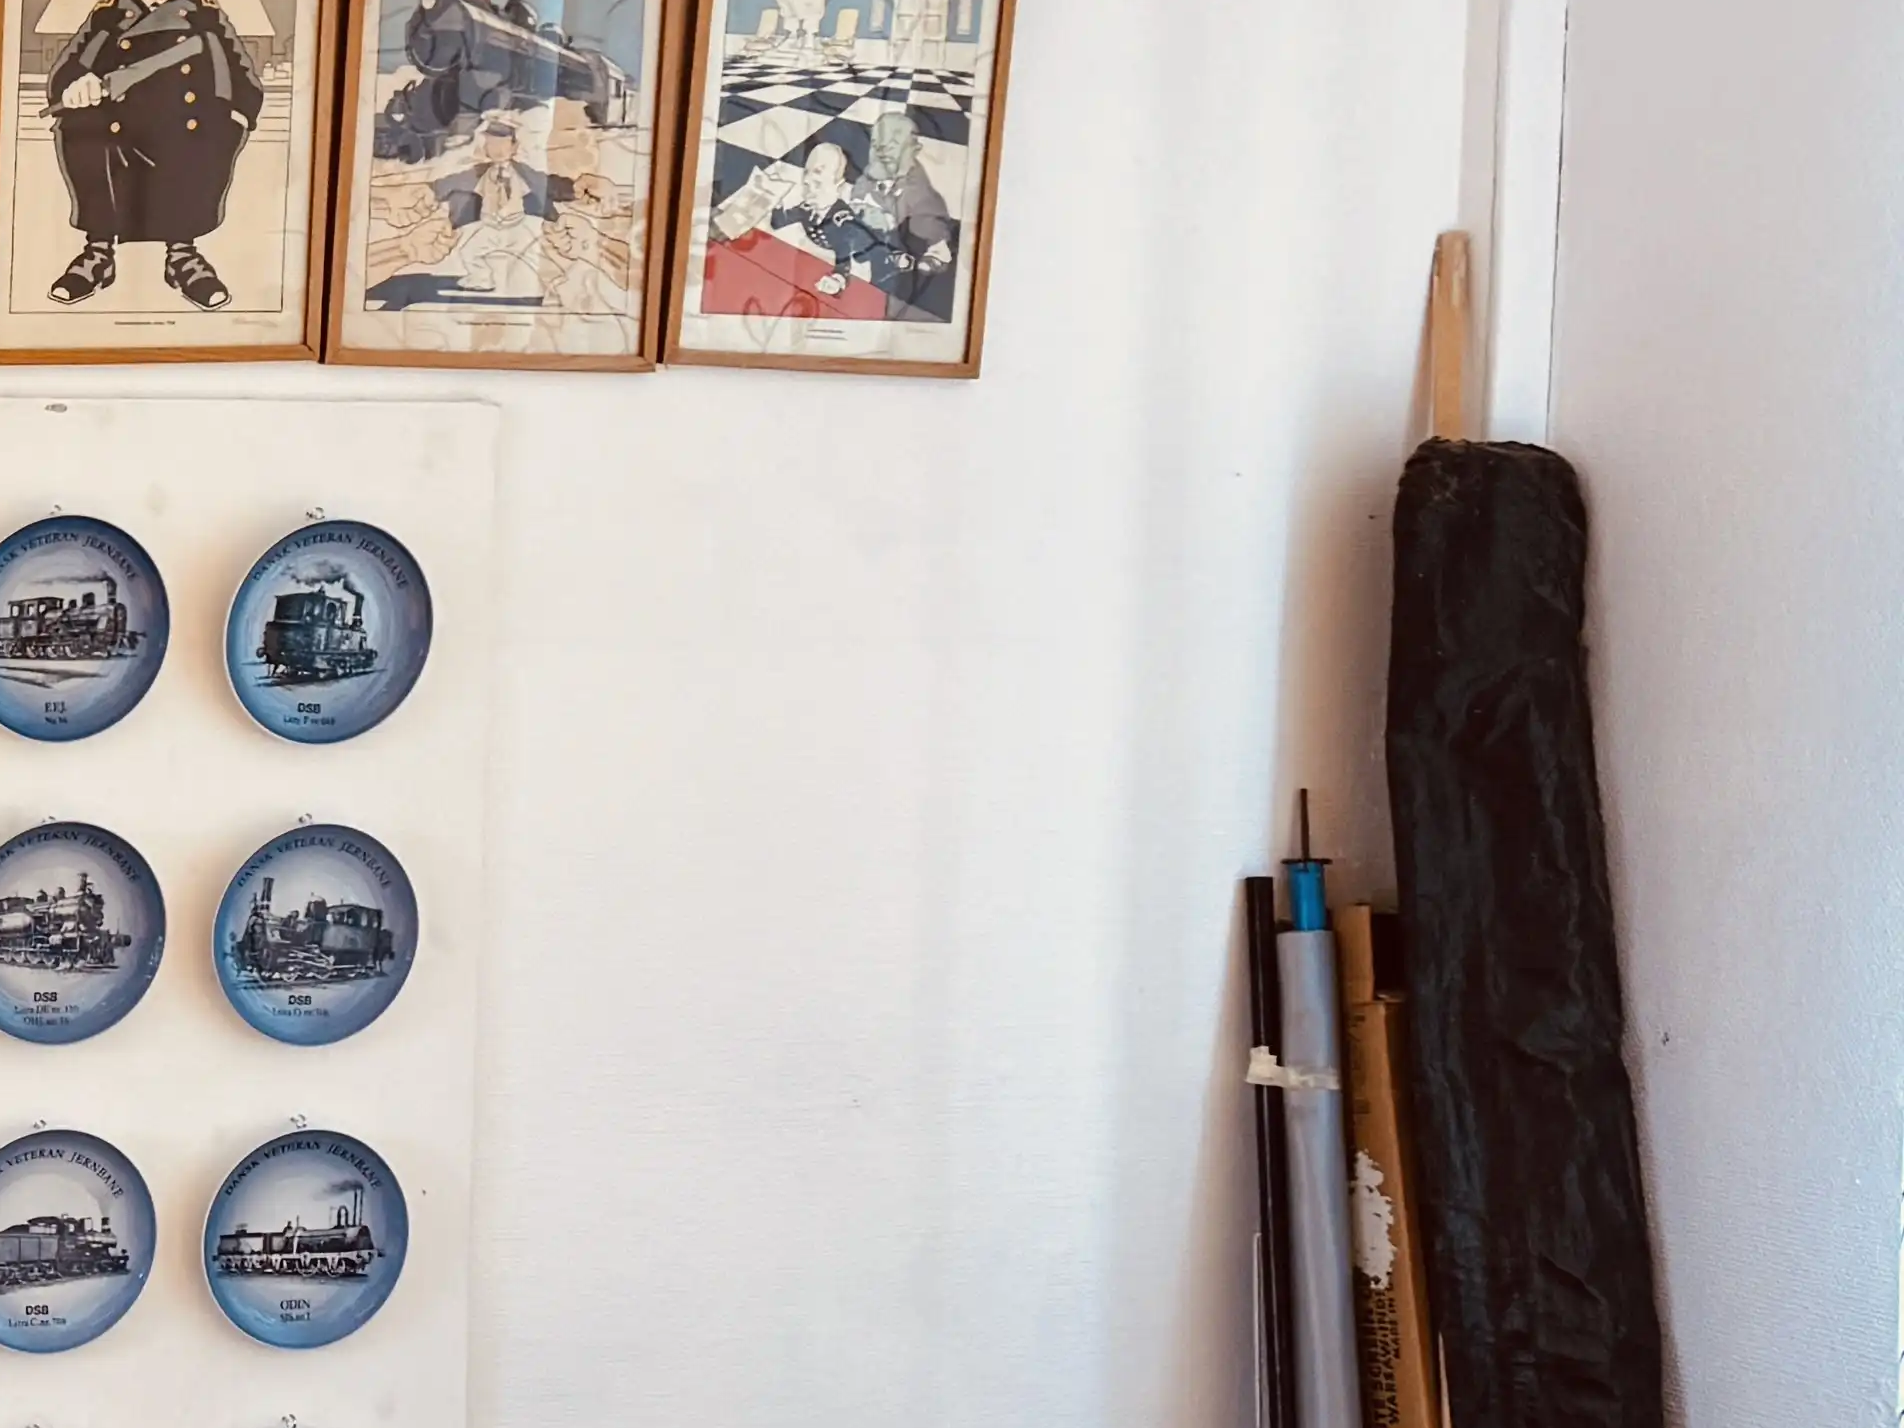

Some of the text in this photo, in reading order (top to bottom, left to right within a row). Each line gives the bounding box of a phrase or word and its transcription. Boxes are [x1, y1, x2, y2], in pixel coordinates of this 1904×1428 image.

[297, 703, 320, 713] DSB
[34, 992, 57, 1002] DSB
[288, 995, 311, 1005] DSB
[280, 1299, 310, 1309] ODIN
[25, 1305, 48, 1315] DSB
